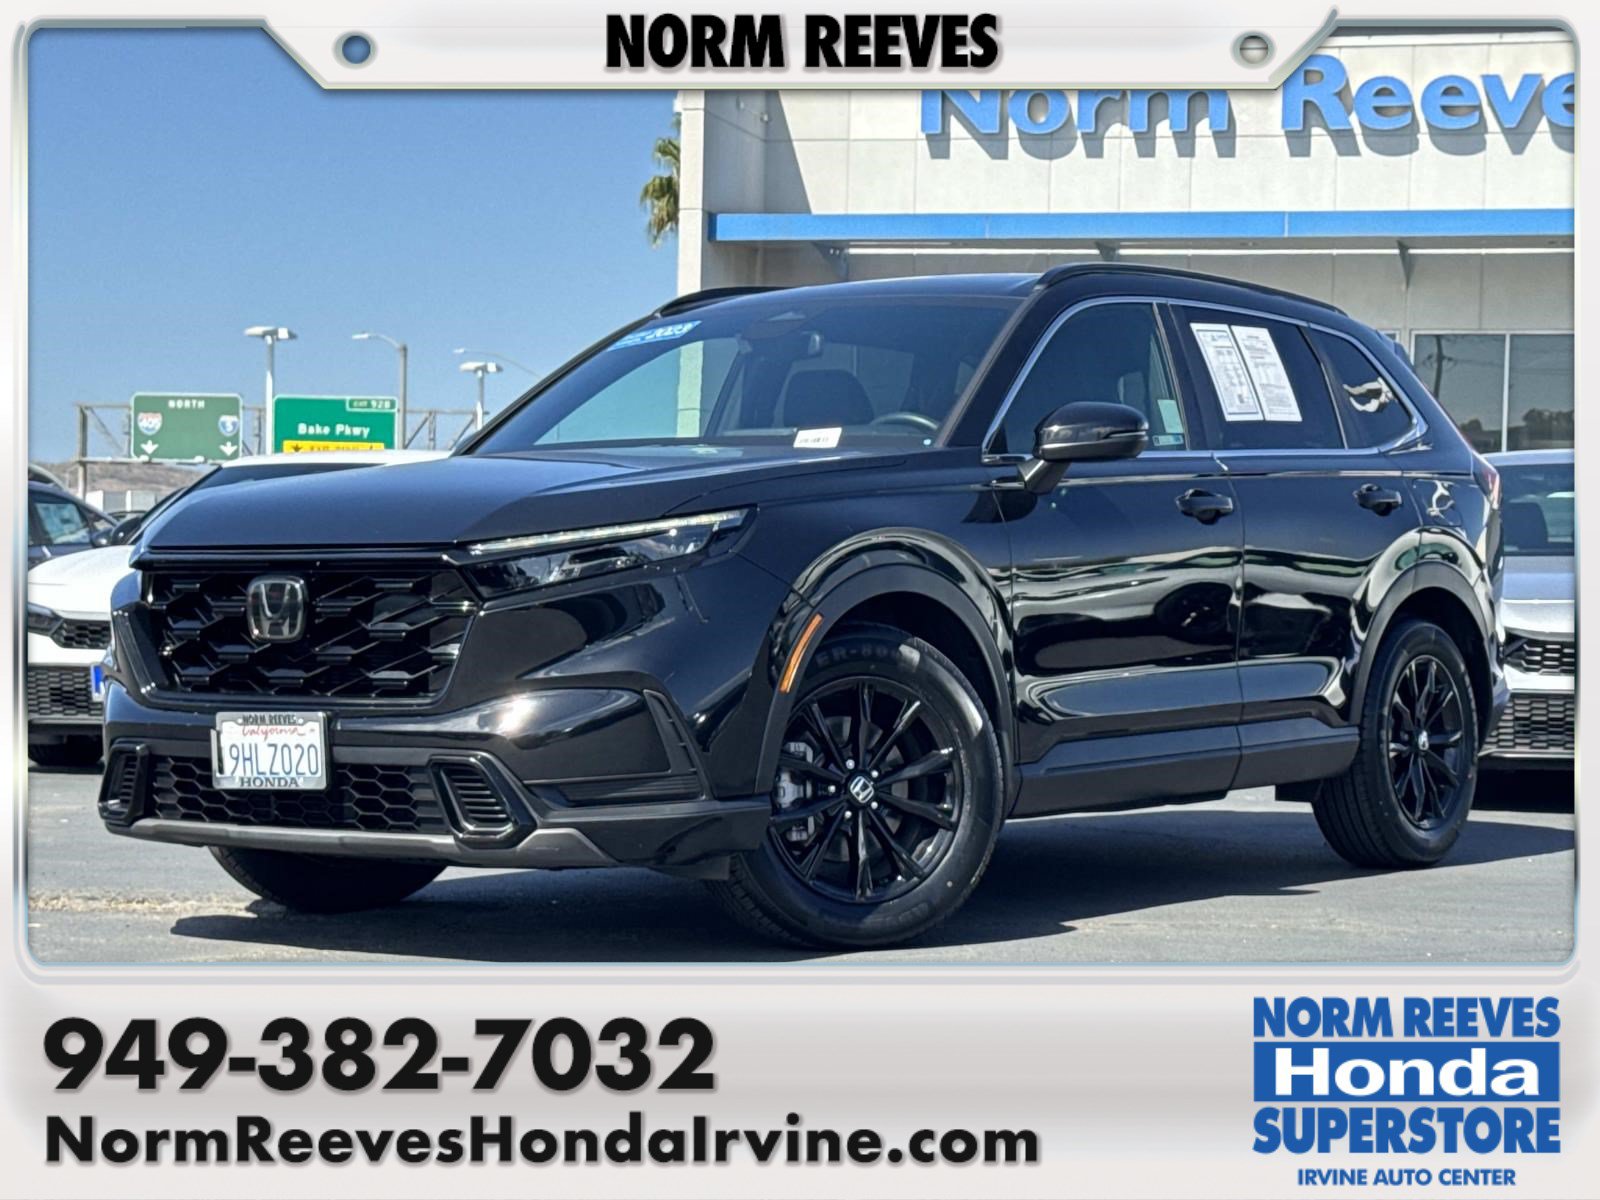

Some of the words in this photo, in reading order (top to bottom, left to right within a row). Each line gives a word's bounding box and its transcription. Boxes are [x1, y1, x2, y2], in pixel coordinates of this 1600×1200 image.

[921, 89, 1230, 134] Norm
[168, 400, 205, 409] NORTH
[297, 422, 330, 435] Bake
[335, 424, 370, 439] Pkwy
[242, 714, 266, 724] NORM
[269, 714, 297, 724] REEVES
[242, 725, 306, 741] California
[229, 743, 319, 776] 9HLZ020
[240, 777, 299, 788] HONDA
